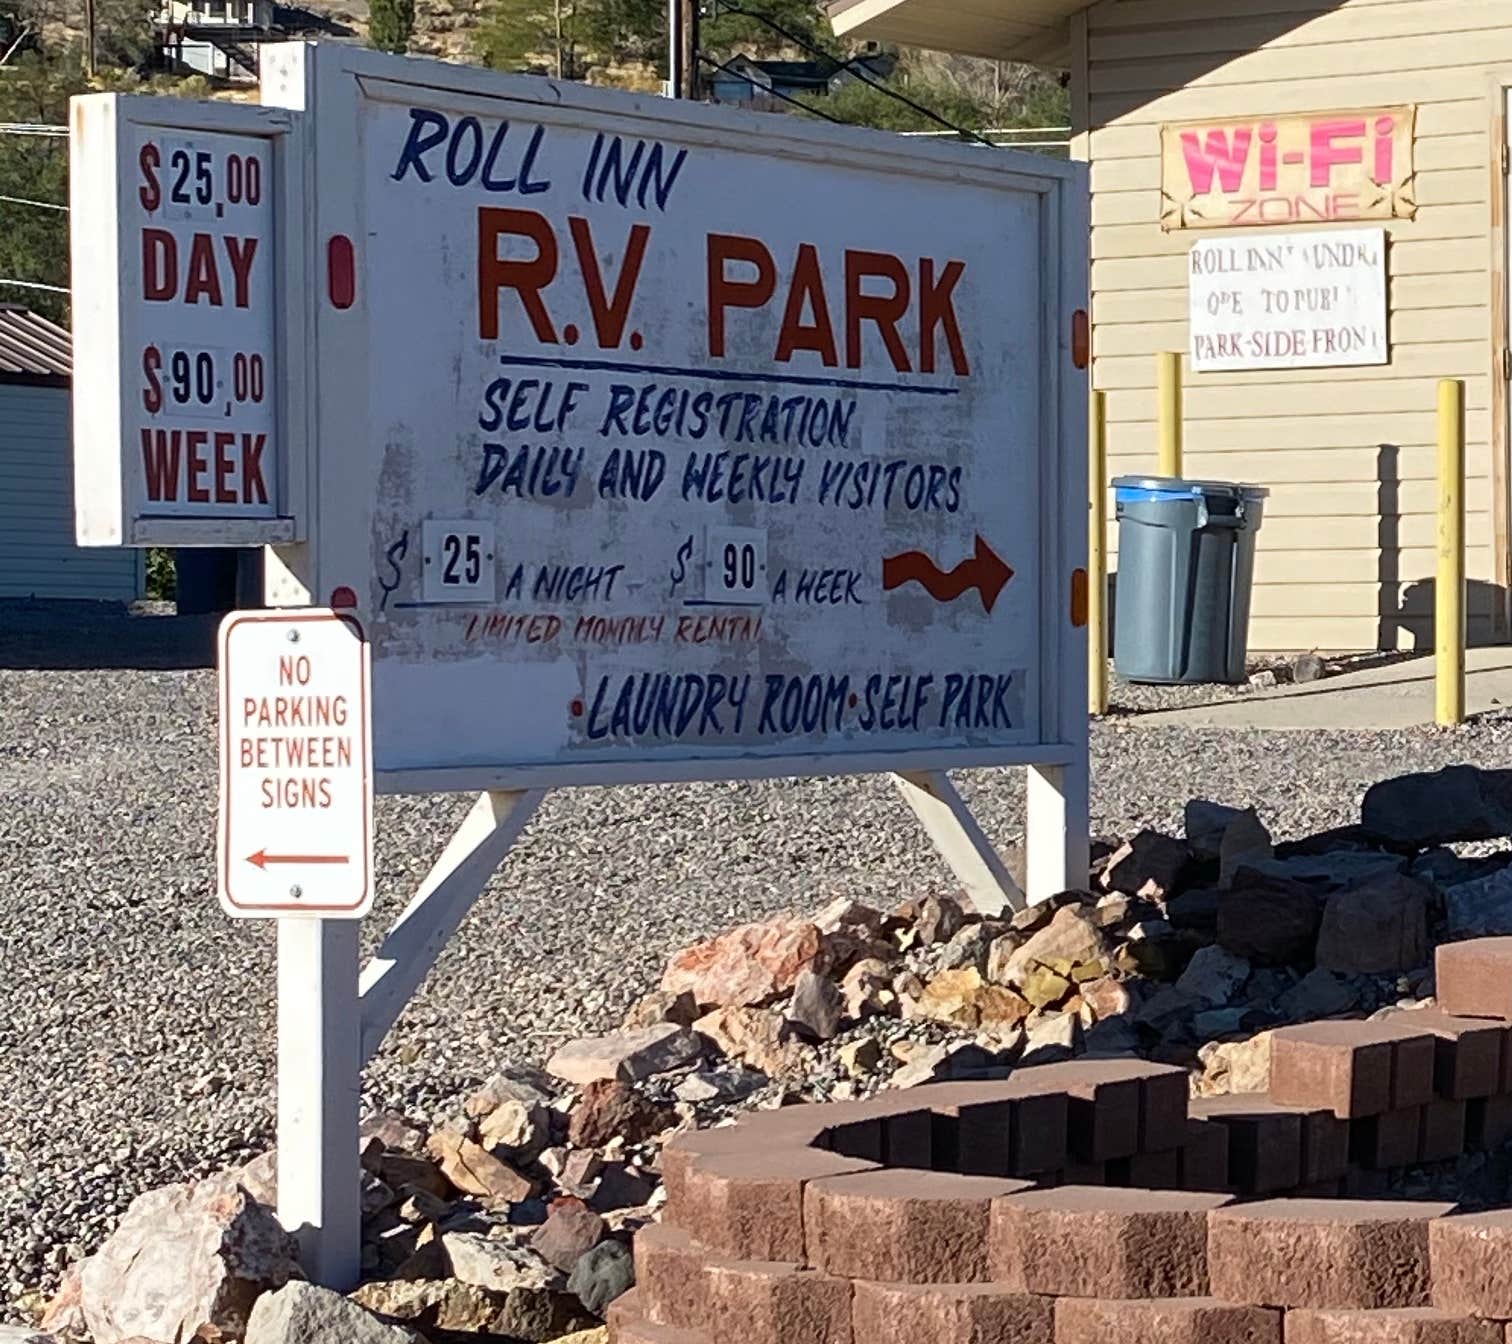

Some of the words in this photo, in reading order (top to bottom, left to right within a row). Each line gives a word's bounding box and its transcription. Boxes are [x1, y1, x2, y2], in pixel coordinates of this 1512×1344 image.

[389, 107, 551, 195] ROLL
[582, 132, 688, 212] INN
[1228, 194, 1361, 225] ZONE
[141, 227, 258, 309] DAY
[1191, 248, 1244, 276] ROLL
[477, 206, 650, 351] R.V.
[707, 232, 970, 376] PARK
[1260, 289, 1290, 314] TO
[478, 377, 590, 432] SELF
[599, 383, 856, 449] REGISTRATION
[141, 428, 268, 504] WEEK
[474, 443, 586, 499] DAILY
[598, 447, 668, 503] AND
[681, 450, 806, 505] WEEKLY
[817, 459, 964, 513] VISITORS
[442, 534, 481, 585] 25
[504, 563, 525, 601] A
[532, 564, 626, 603] NIGHT
[722, 543, 755, 589] 90
[772, 569, 788, 599] A
[794, 569, 864, 605] WEEK
[464, 613, 562, 643] LIMITED
[573, 614, 666, 644] MONTHLY
[279, 655, 312, 686] NO
[243, 696, 348, 727] PARKING
[587, 672, 752, 739] LAUNDRY
[757, 673, 847, 735] ROOM
[857, 673, 934, 731] SELF
[940, 672, 1016, 730] PARK
[240, 736, 352, 768] BETWEEN
[261, 777, 333, 808] SIGNS
